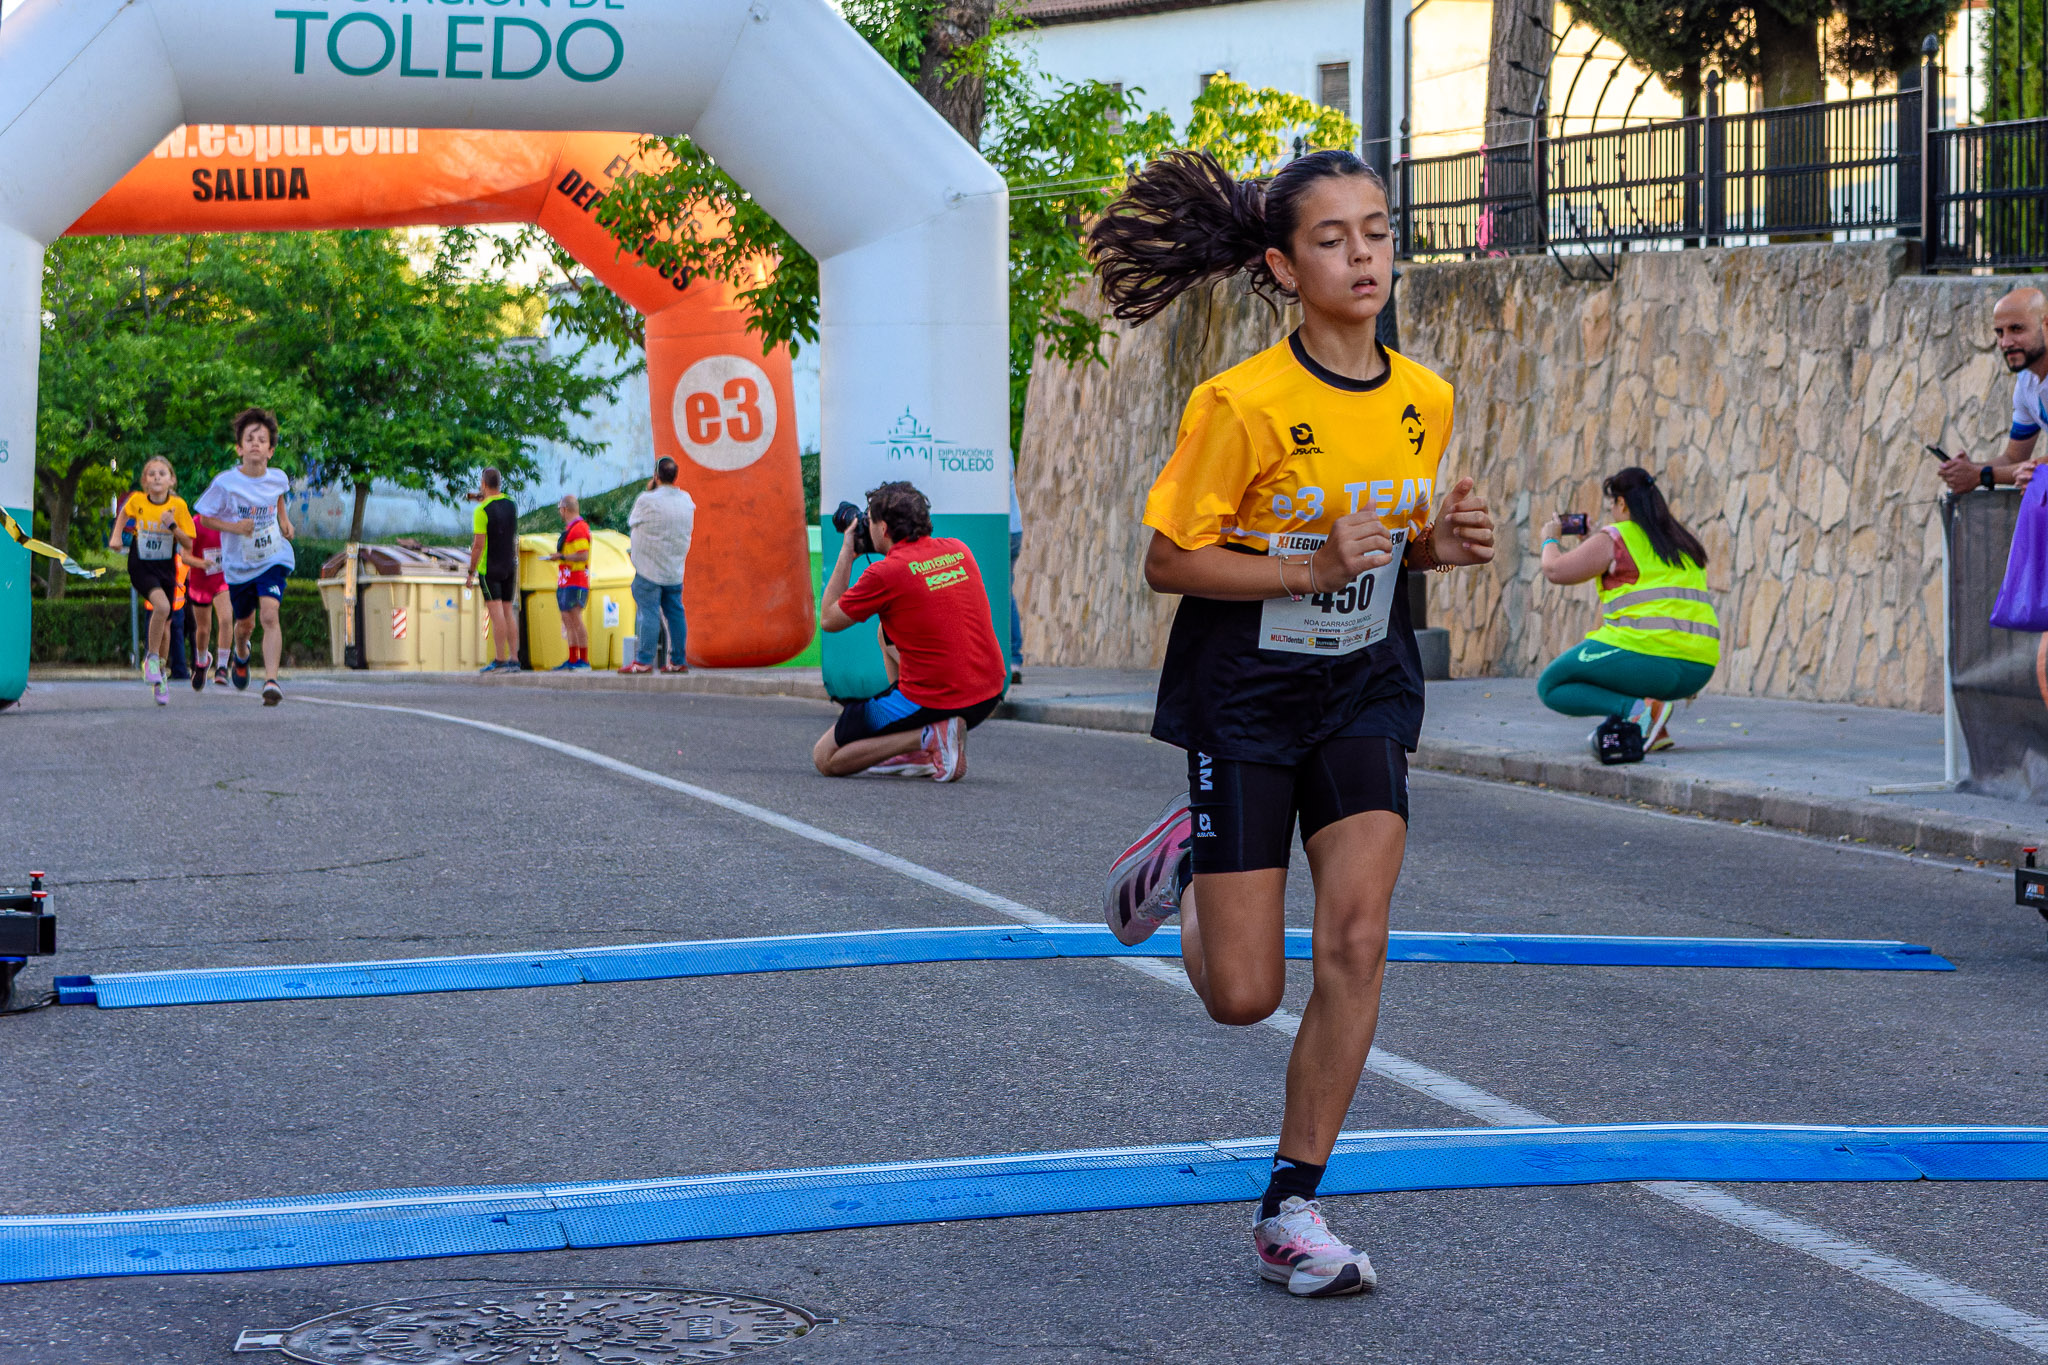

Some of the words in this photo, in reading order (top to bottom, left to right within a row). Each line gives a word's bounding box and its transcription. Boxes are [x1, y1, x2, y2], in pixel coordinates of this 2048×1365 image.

[275, 10, 624, 83] TOLEDO
[192, 167, 311, 202] SALIDA
[685, 377, 764, 445] e3
[938, 448, 985, 457] DIPUTACIÓN
[939, 458, 994, 472] TOLEDO
[1272, 486, 1325, 522] e3
[254, 534, 272, 549] 454
[1311, 574, 1375, 614] 450
[1304, 618, 1319, 627] NOA
[1320, 618, 1357, 628] CARRASCO
[1270, 633, 1304, 645] MULTIdental
